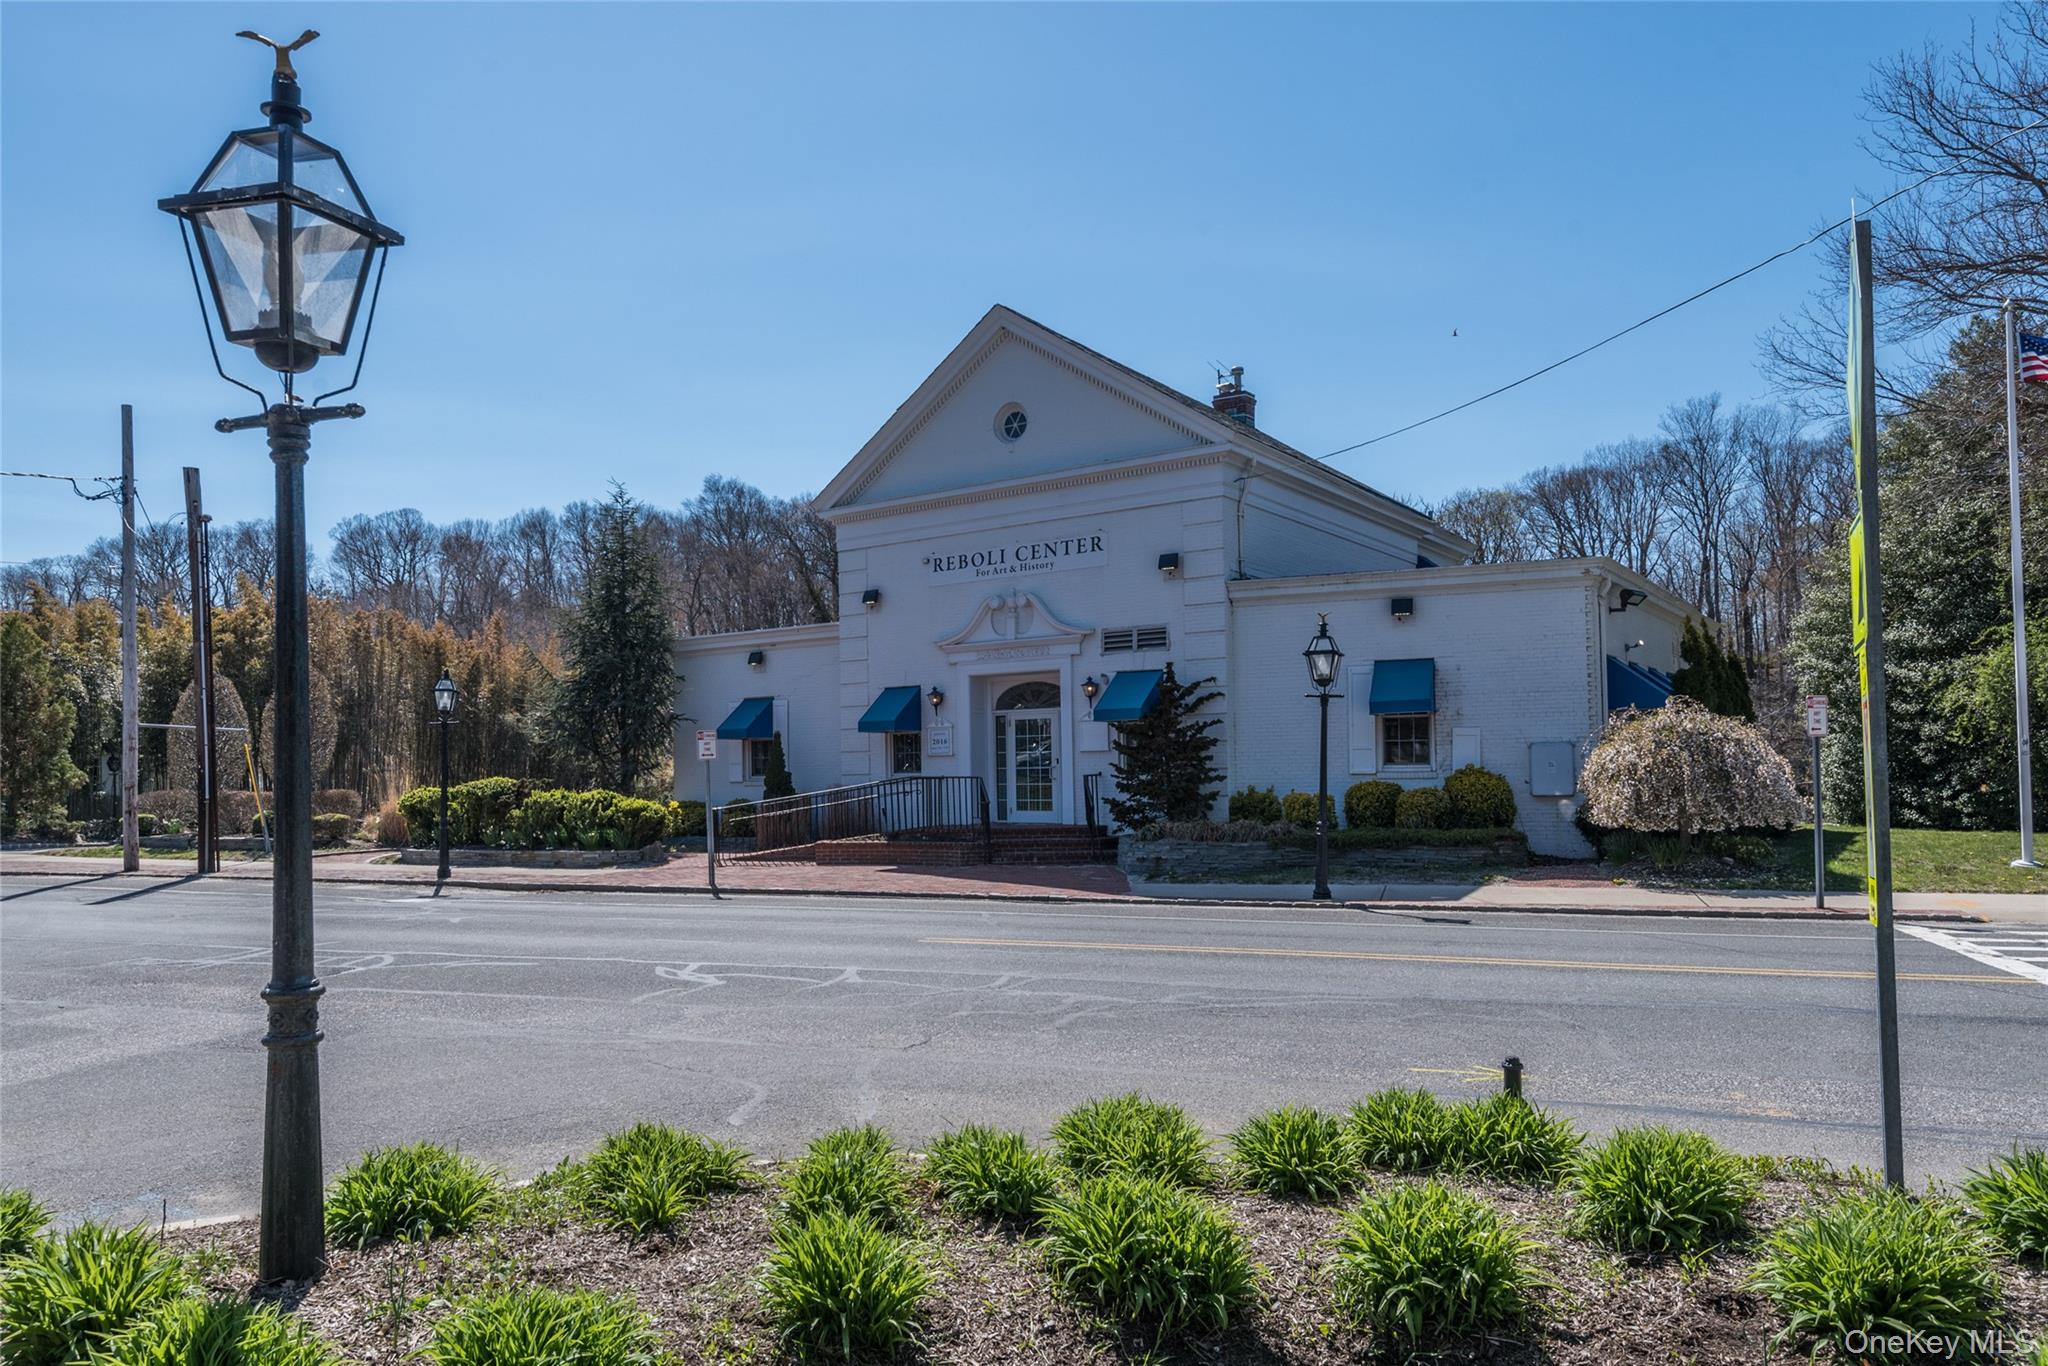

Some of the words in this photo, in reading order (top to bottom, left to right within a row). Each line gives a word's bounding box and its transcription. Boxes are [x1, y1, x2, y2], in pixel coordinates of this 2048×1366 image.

[933, 549, 1006, 573] REBOLI
[1015, 535, 1105, 562] CENTER
[976, 568, 991, 577] For
[992, 566, 1008, 575] Art
[1009, 565, 1017, 574] &
[1019, 561, 1055, 572] History
